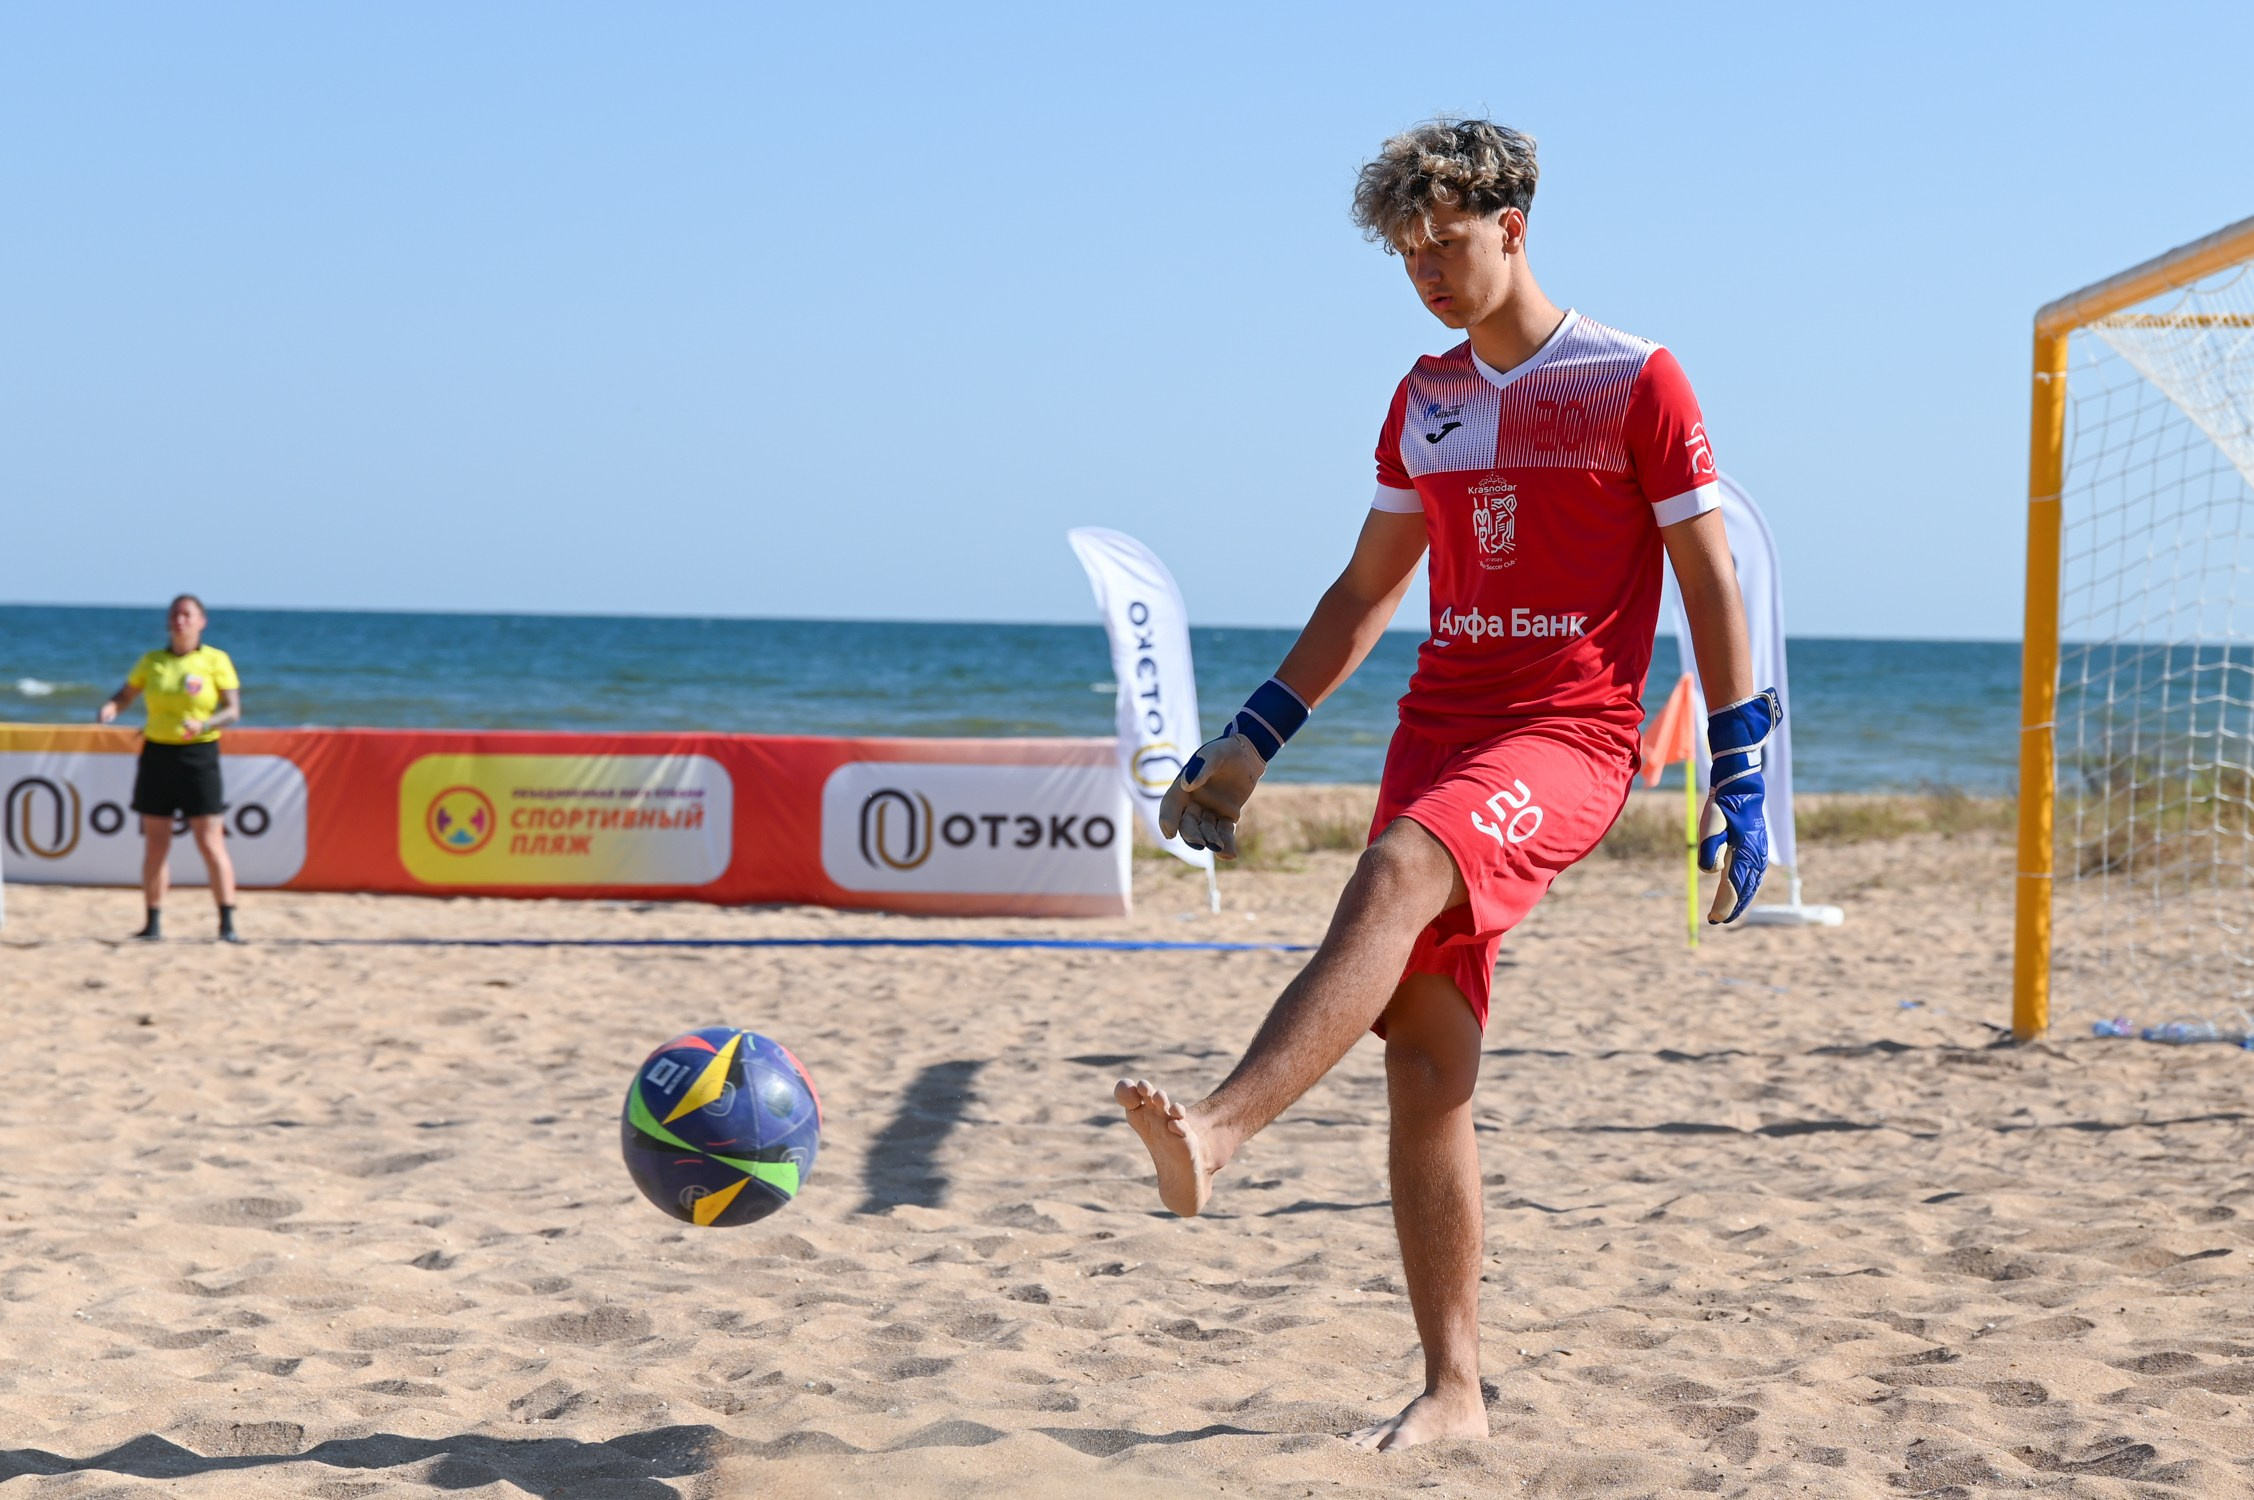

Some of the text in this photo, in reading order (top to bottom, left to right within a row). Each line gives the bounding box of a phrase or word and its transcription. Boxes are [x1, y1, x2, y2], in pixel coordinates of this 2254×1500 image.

[1467, 484, 1518, 495] Krasnodar
[1511, 607, 1589, 638] Банк
[510, 803, 705, 831] СПОРТИВНЫЙ
[1486, 778, 1544, 844] 20
[510, 833, 594, 857] ПЛЯЖ
[941, 812, 1117, 850] ОТЭКО
